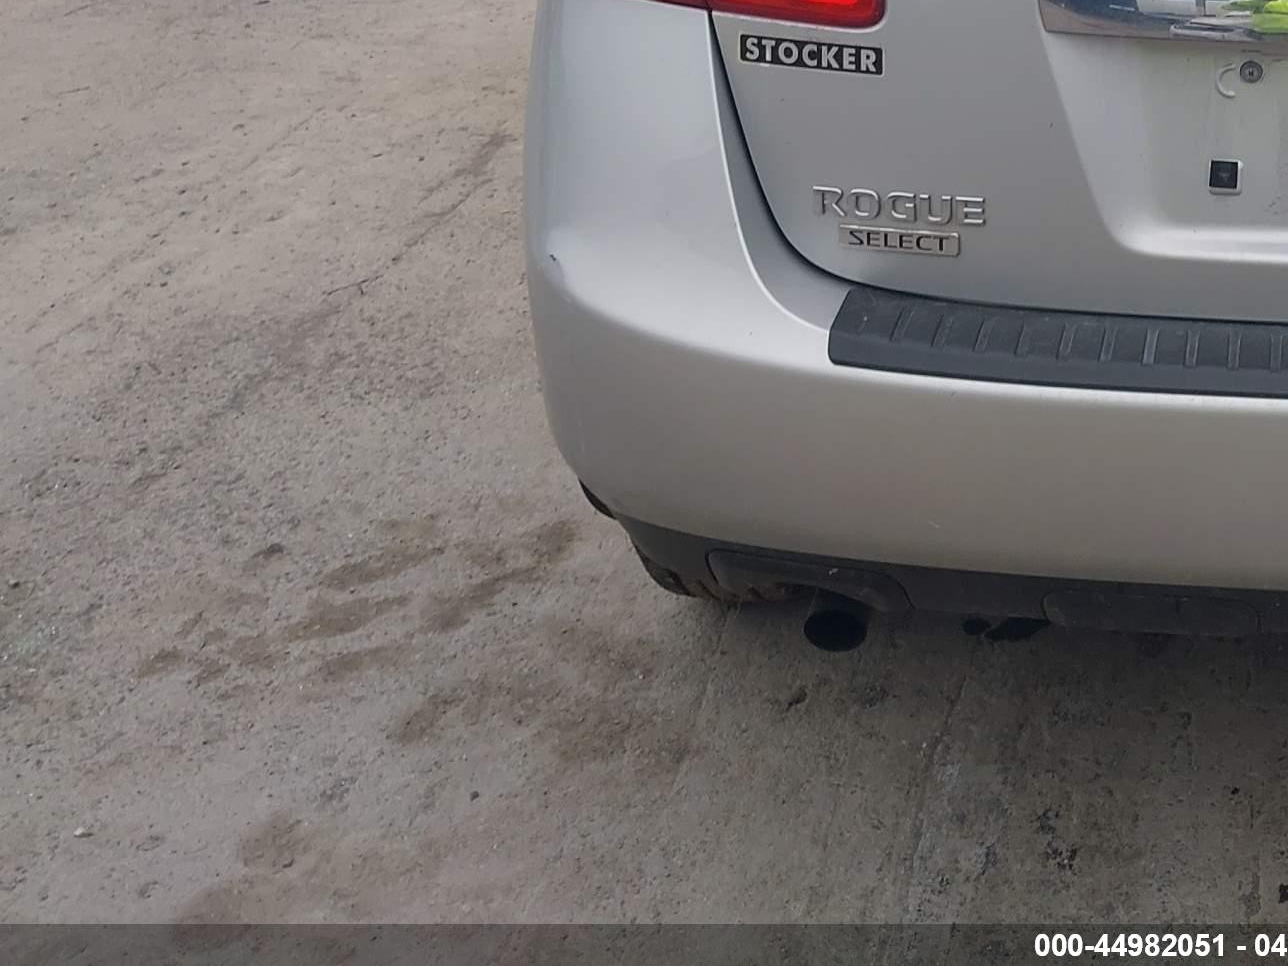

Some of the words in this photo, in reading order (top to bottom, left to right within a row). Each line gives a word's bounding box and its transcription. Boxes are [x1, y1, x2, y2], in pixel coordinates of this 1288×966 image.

[745, 37, 877, 72] STOCKER
[812, 185, 985, 225] ROGUE
[848, 230, 950, 251] SELECT
